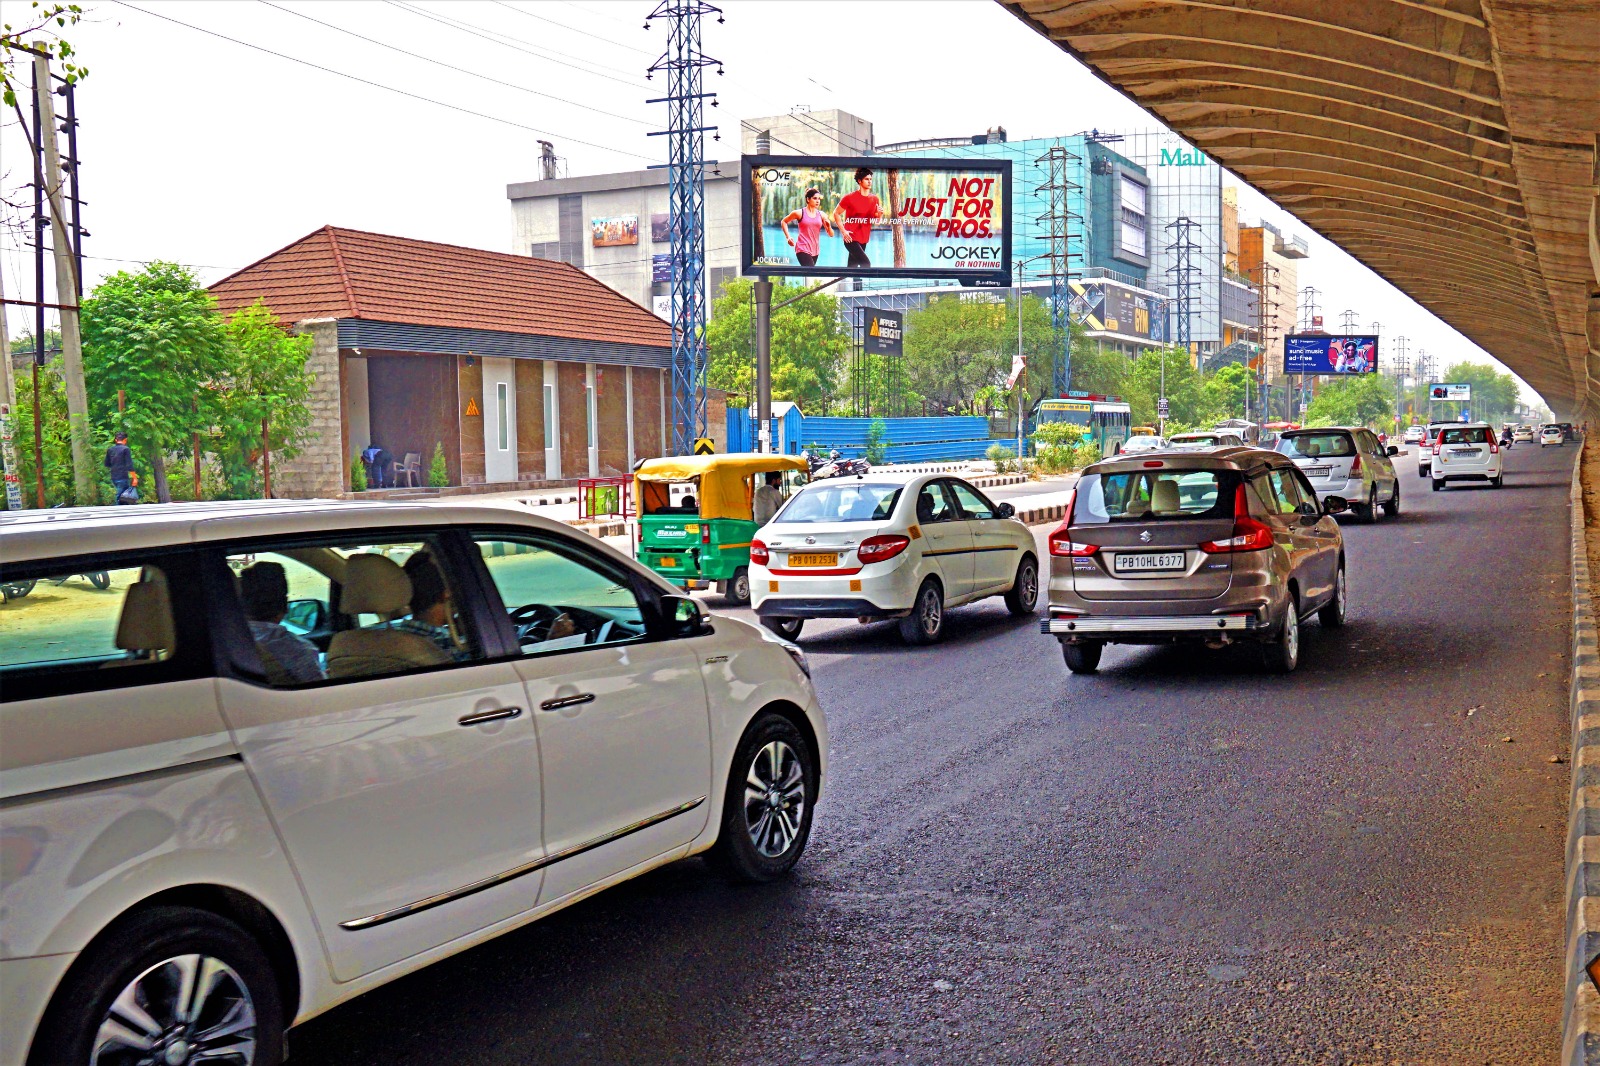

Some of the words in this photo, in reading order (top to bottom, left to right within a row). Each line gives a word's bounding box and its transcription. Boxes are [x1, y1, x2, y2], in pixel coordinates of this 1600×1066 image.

[1159, 147, 1206, 166] Mall
[755, 169, 790, 182] MOVE
[948, 178, 995, 198] NOT
[898, 198, 948, 217] JUST
[951, 198, 994, 218] FOR
[935, 218, 993, 238] PROS.
[930, 246, 1001, 259] JOCKEY
[755, 256, 790, 264] JOCKEY.IN
[793, 555, 802, 565] PB
[818, 555, 836, 564] 2534
[1122, 555, 1183, 568] PB10HL6377
